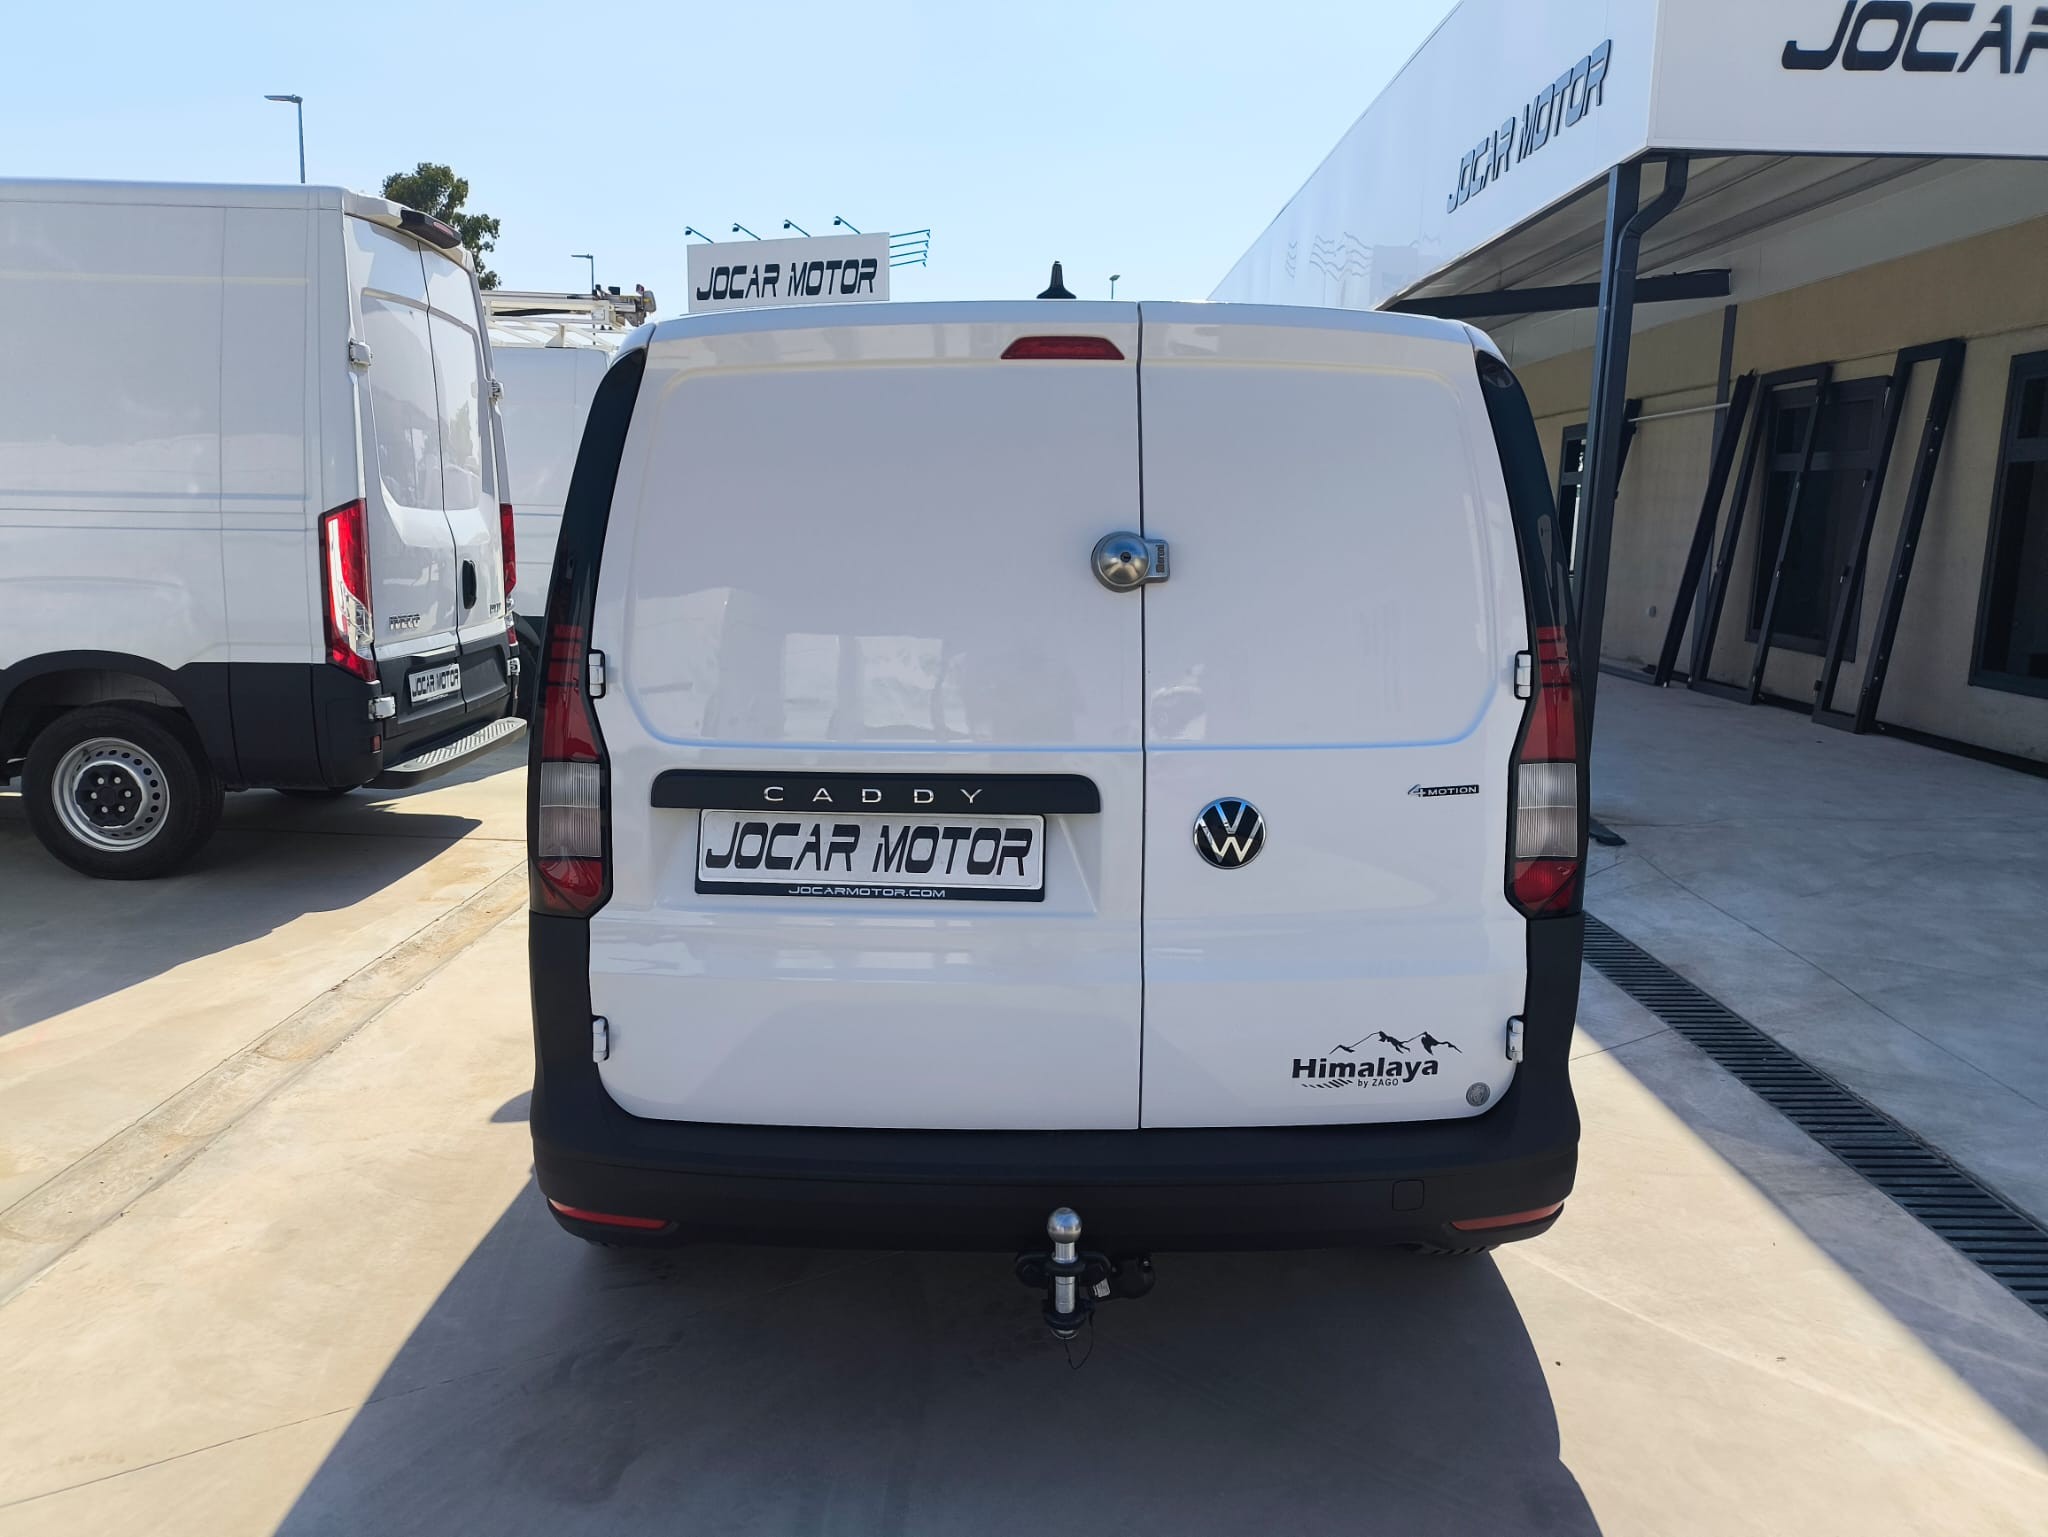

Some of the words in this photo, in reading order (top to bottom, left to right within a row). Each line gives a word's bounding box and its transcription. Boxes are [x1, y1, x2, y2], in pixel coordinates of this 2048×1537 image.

[1447, 116, 1516, 213] JOCAR
[1516, 39, 1613, 164] MOTOR
[696, 263, 780, 300] JOCAR
[787, 258, 877, 297] MOTOR
[413, 675, 435, 697] JOCAR
[436, 668, 459, 691] MOTOR
[763, 786, 983, 804] CADDY
[705, 822, 861, 872] JOCAR
[871, 825, 1033, 876] MOTOR
[788, 885, 946, 898] JOCARMOTOR.COM
[1291, 1057, 1439, 1083] Himalaya
[1357, 1078, 1369, 1088] by
[1371, 1078, 1399, 1087] ZAGO
